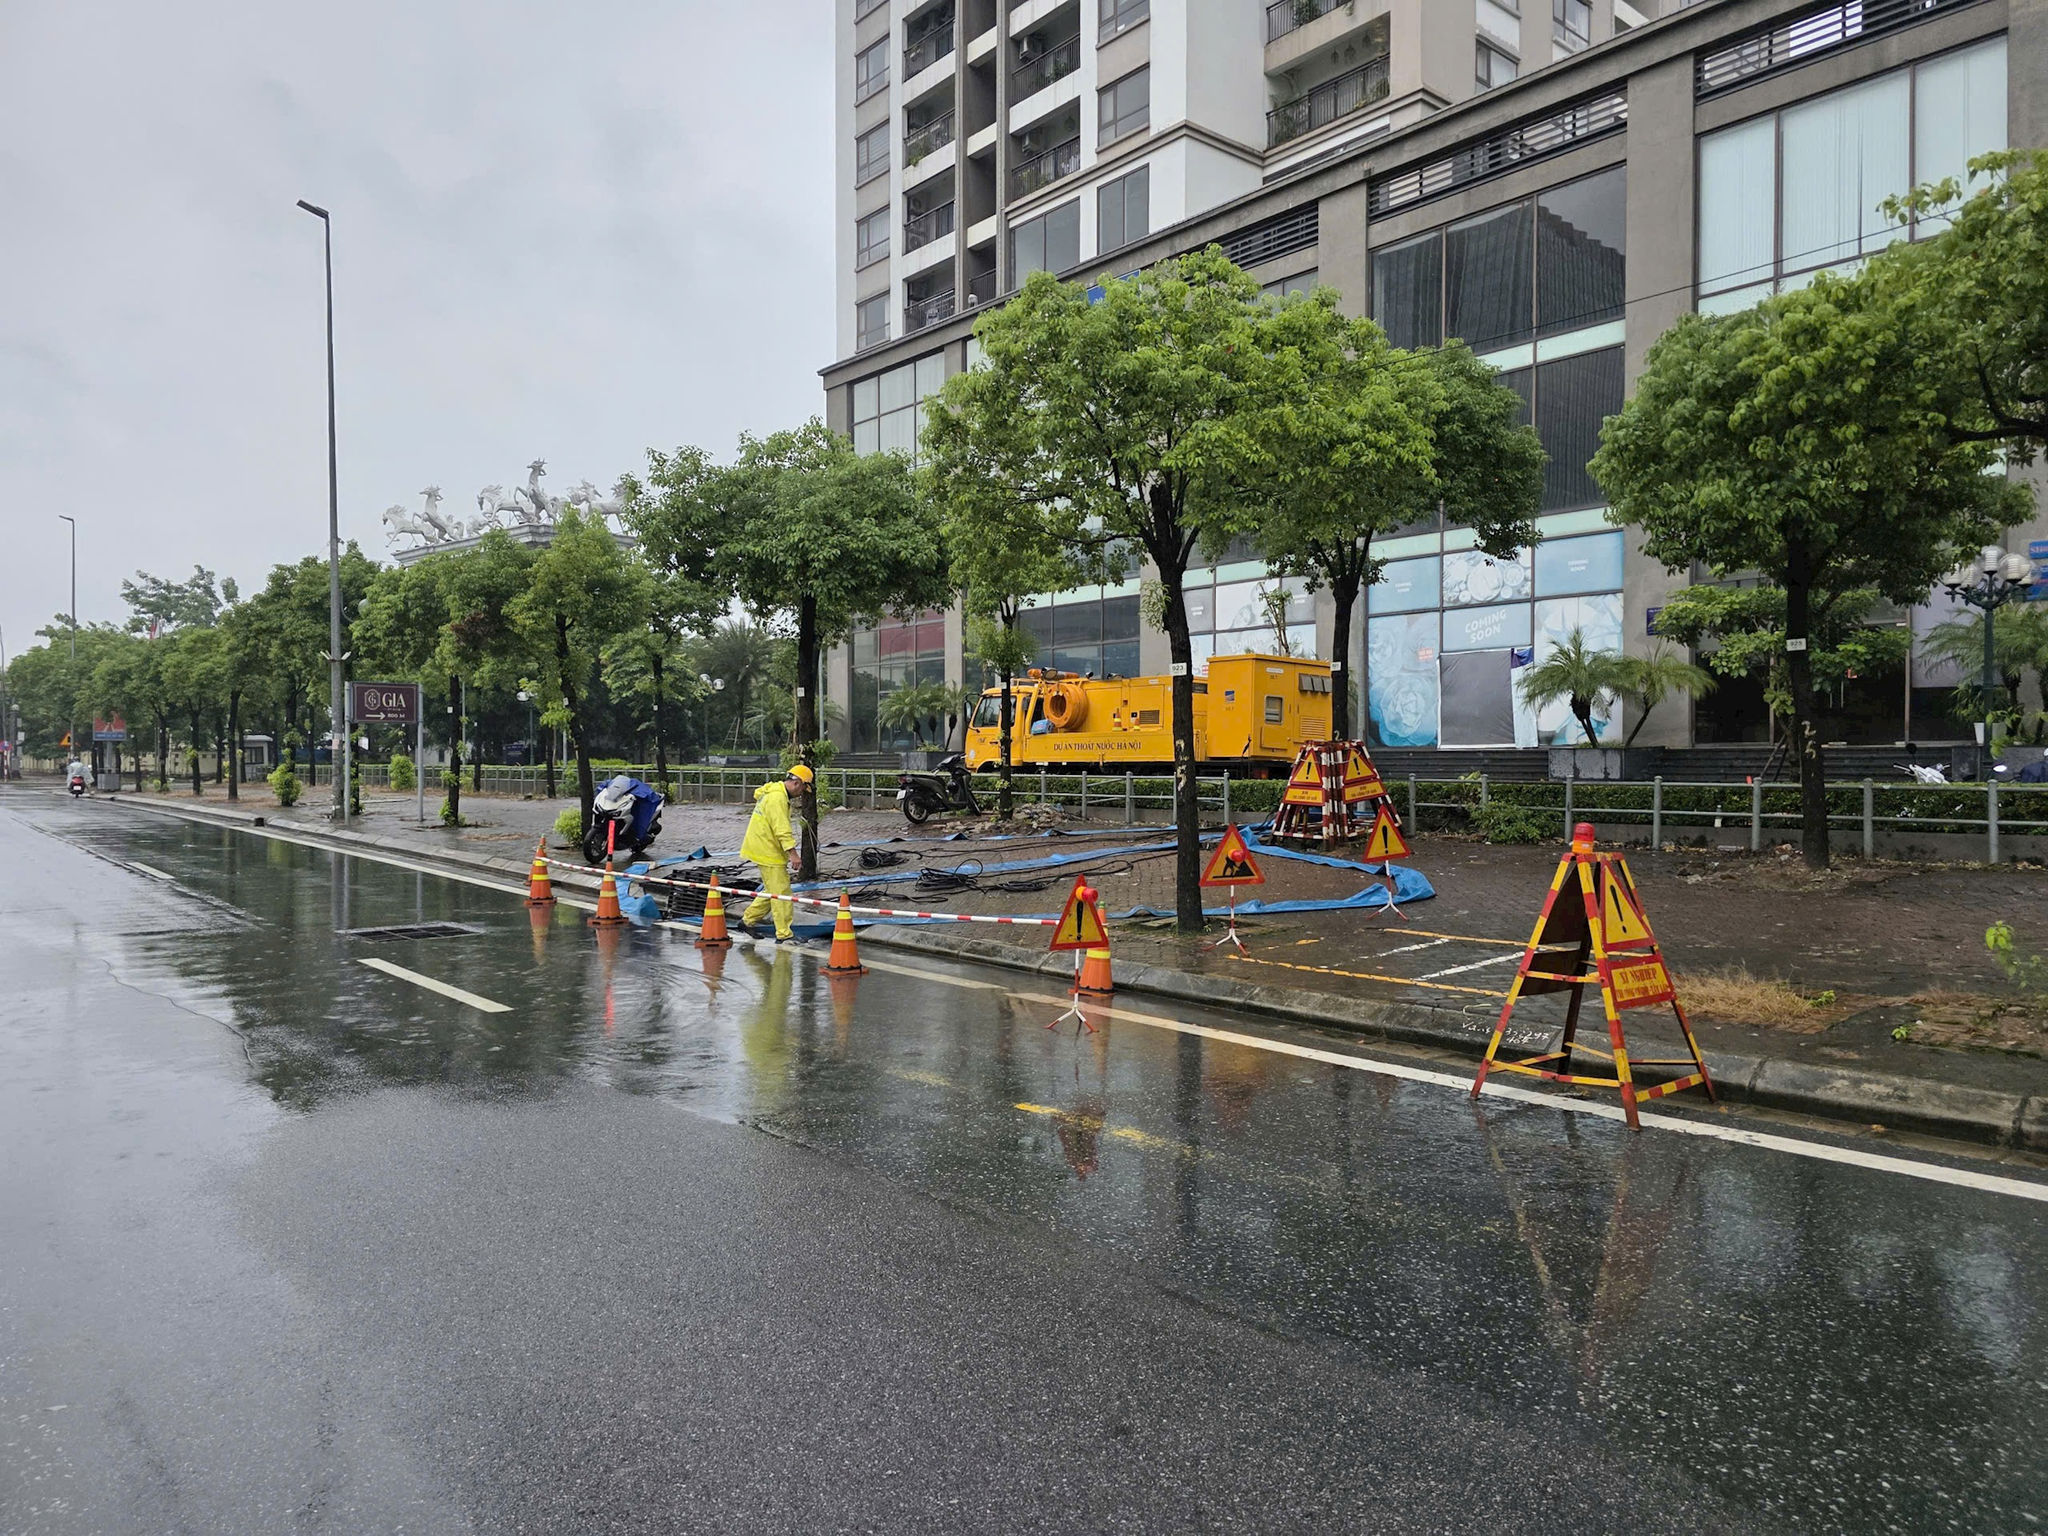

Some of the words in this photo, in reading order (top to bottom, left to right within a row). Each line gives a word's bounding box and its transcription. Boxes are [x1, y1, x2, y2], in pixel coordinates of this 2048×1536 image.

[1465, 609, 1508, 633] COMING
[1470, 623, 1501, 643] SOON
[382, 692, 406, 708] GIA
[1074, 740, 1095, 751] THOÁT
[1128, 739, 1142, 751] NỘI
